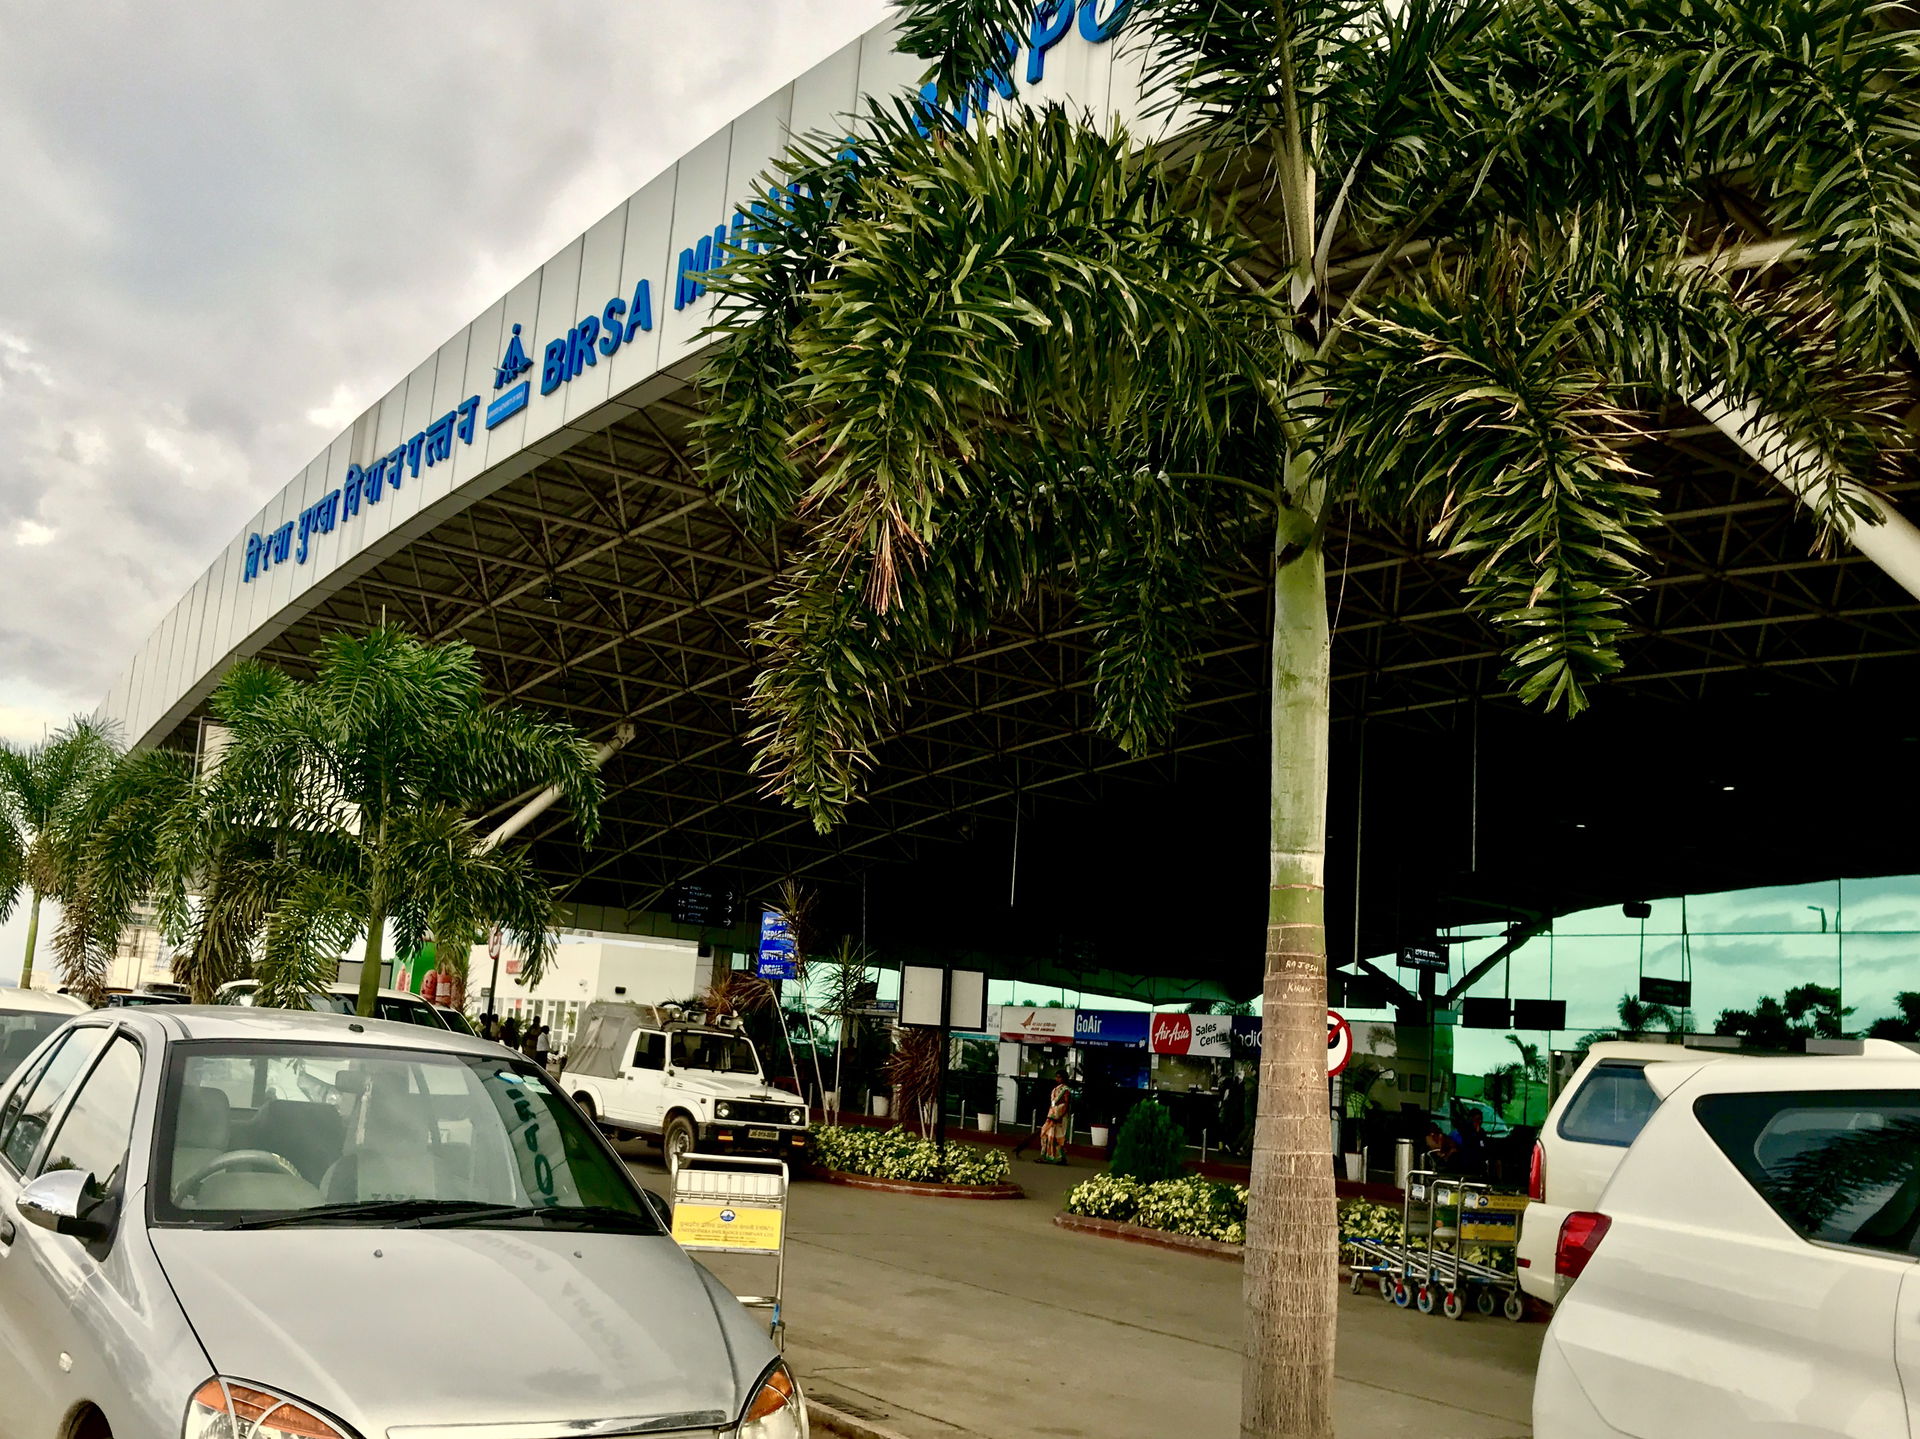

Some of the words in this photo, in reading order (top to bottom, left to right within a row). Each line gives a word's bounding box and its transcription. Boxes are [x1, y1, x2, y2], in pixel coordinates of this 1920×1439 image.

[540, 278, 653, 396] BIRSA
[1075, 1014, 1102, 1034] GoAir
[1195, 1023, 1217, 1036] Sales
